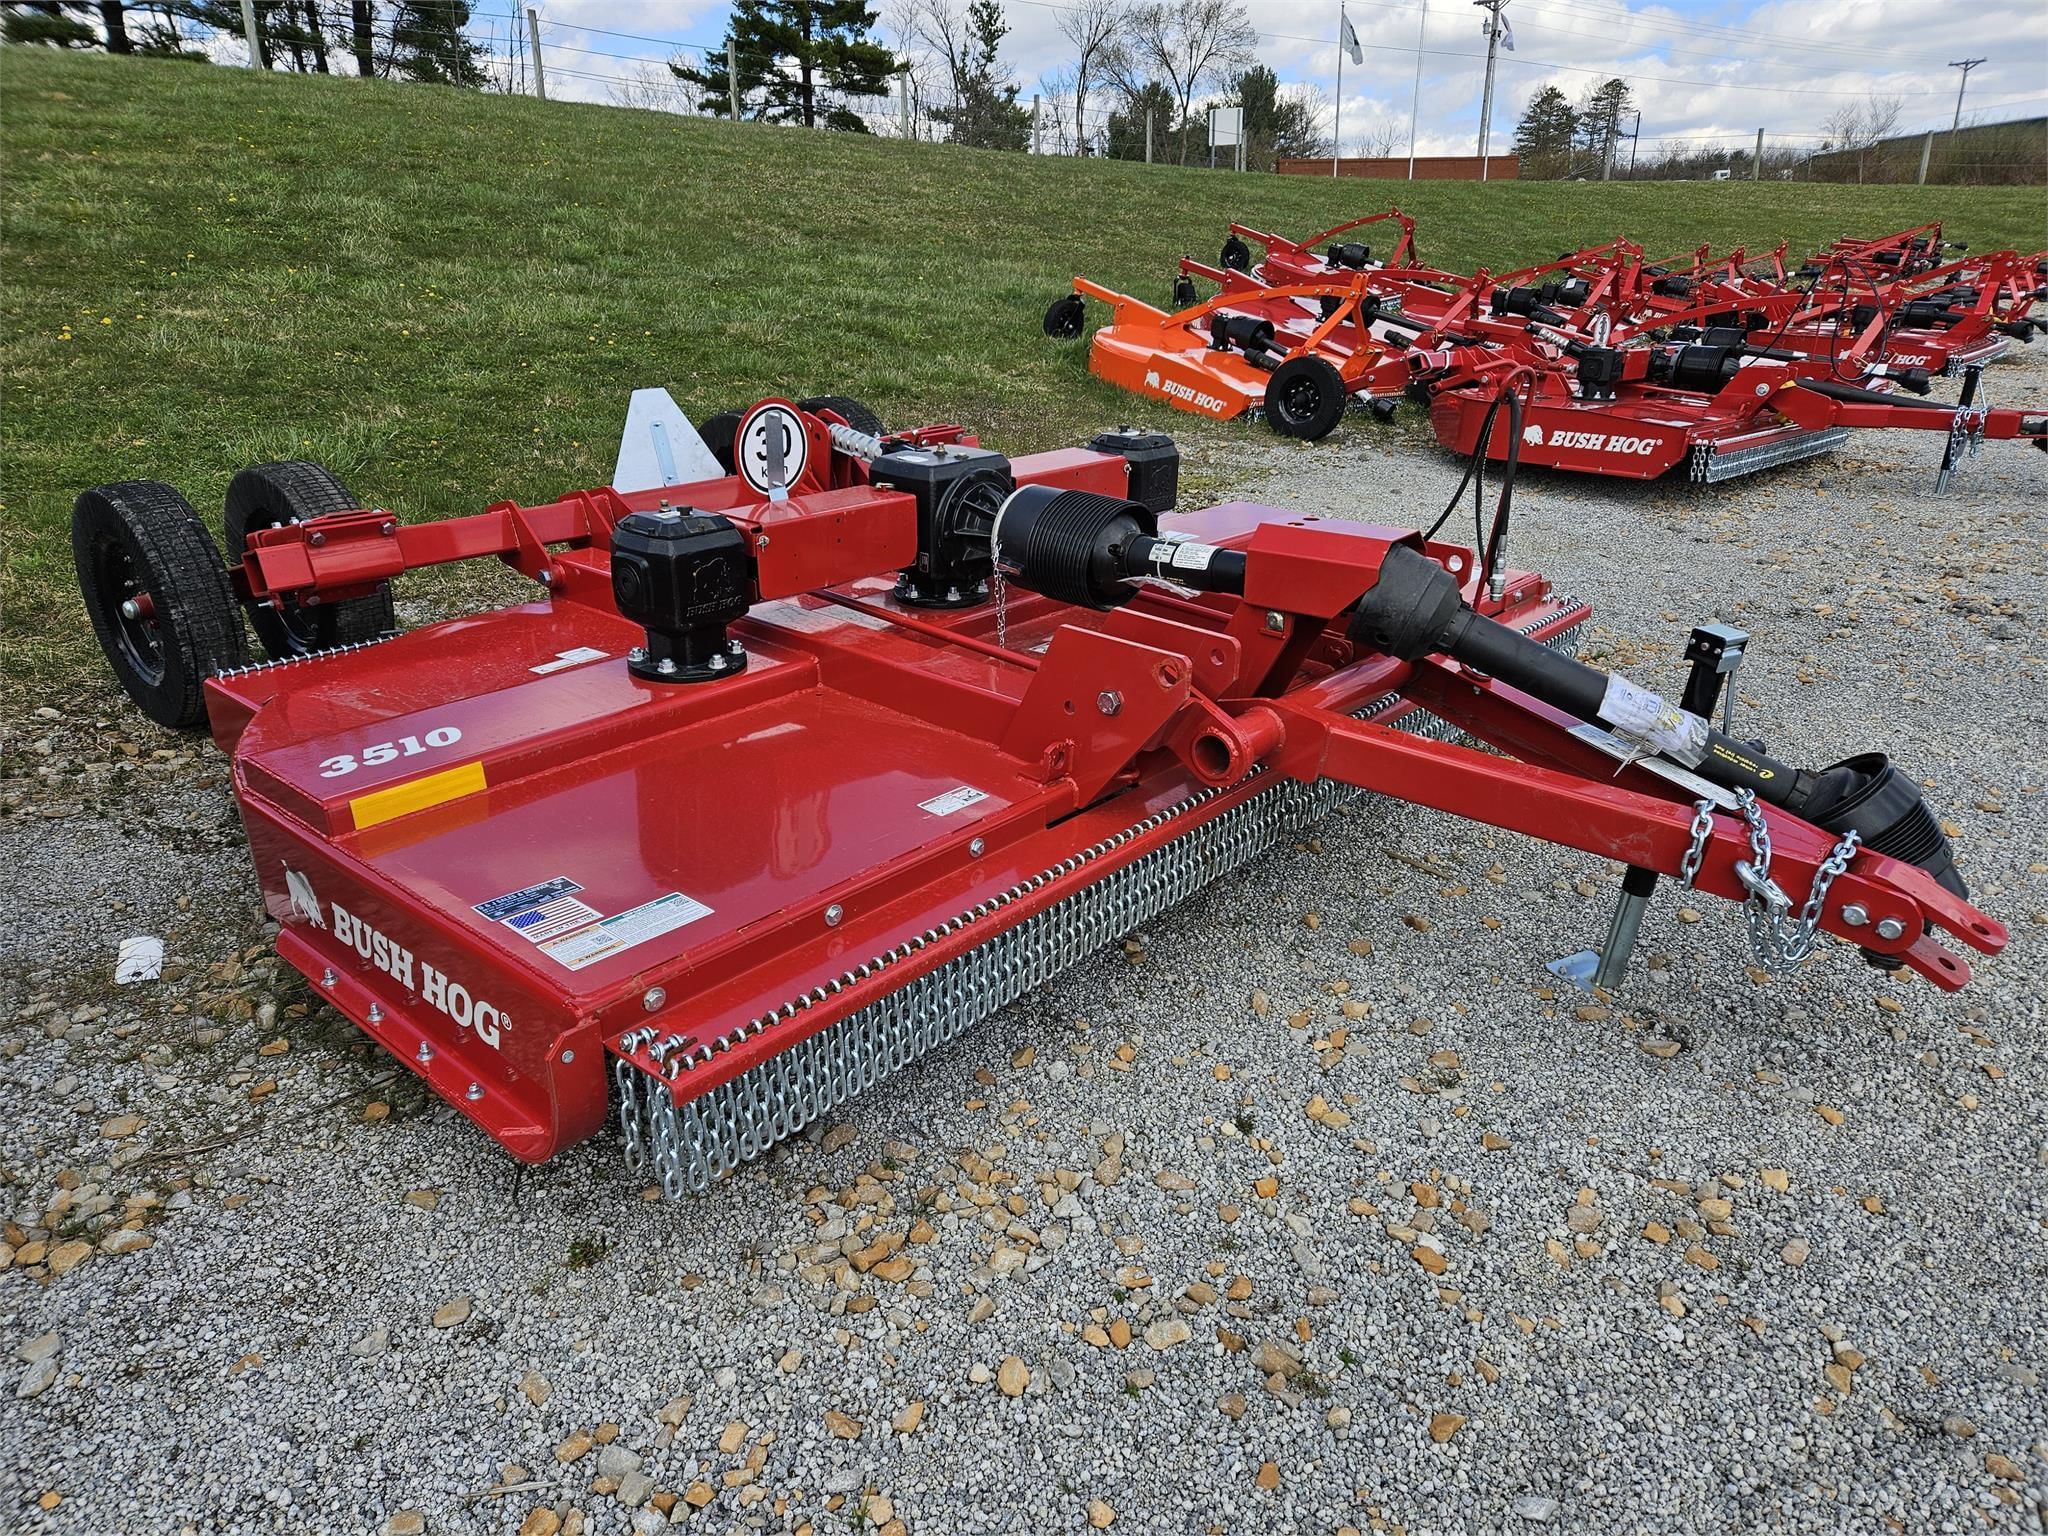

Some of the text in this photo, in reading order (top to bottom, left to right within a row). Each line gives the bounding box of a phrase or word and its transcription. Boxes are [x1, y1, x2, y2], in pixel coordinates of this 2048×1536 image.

[1161, 379, 1196, 402] BUSH
[1548, 430, 1607, 451] BUSH
[319, 726, 462, 778] 3510
[331, 901, 415, 992] BUSH
[585, 944, 616, 959] WARNING
